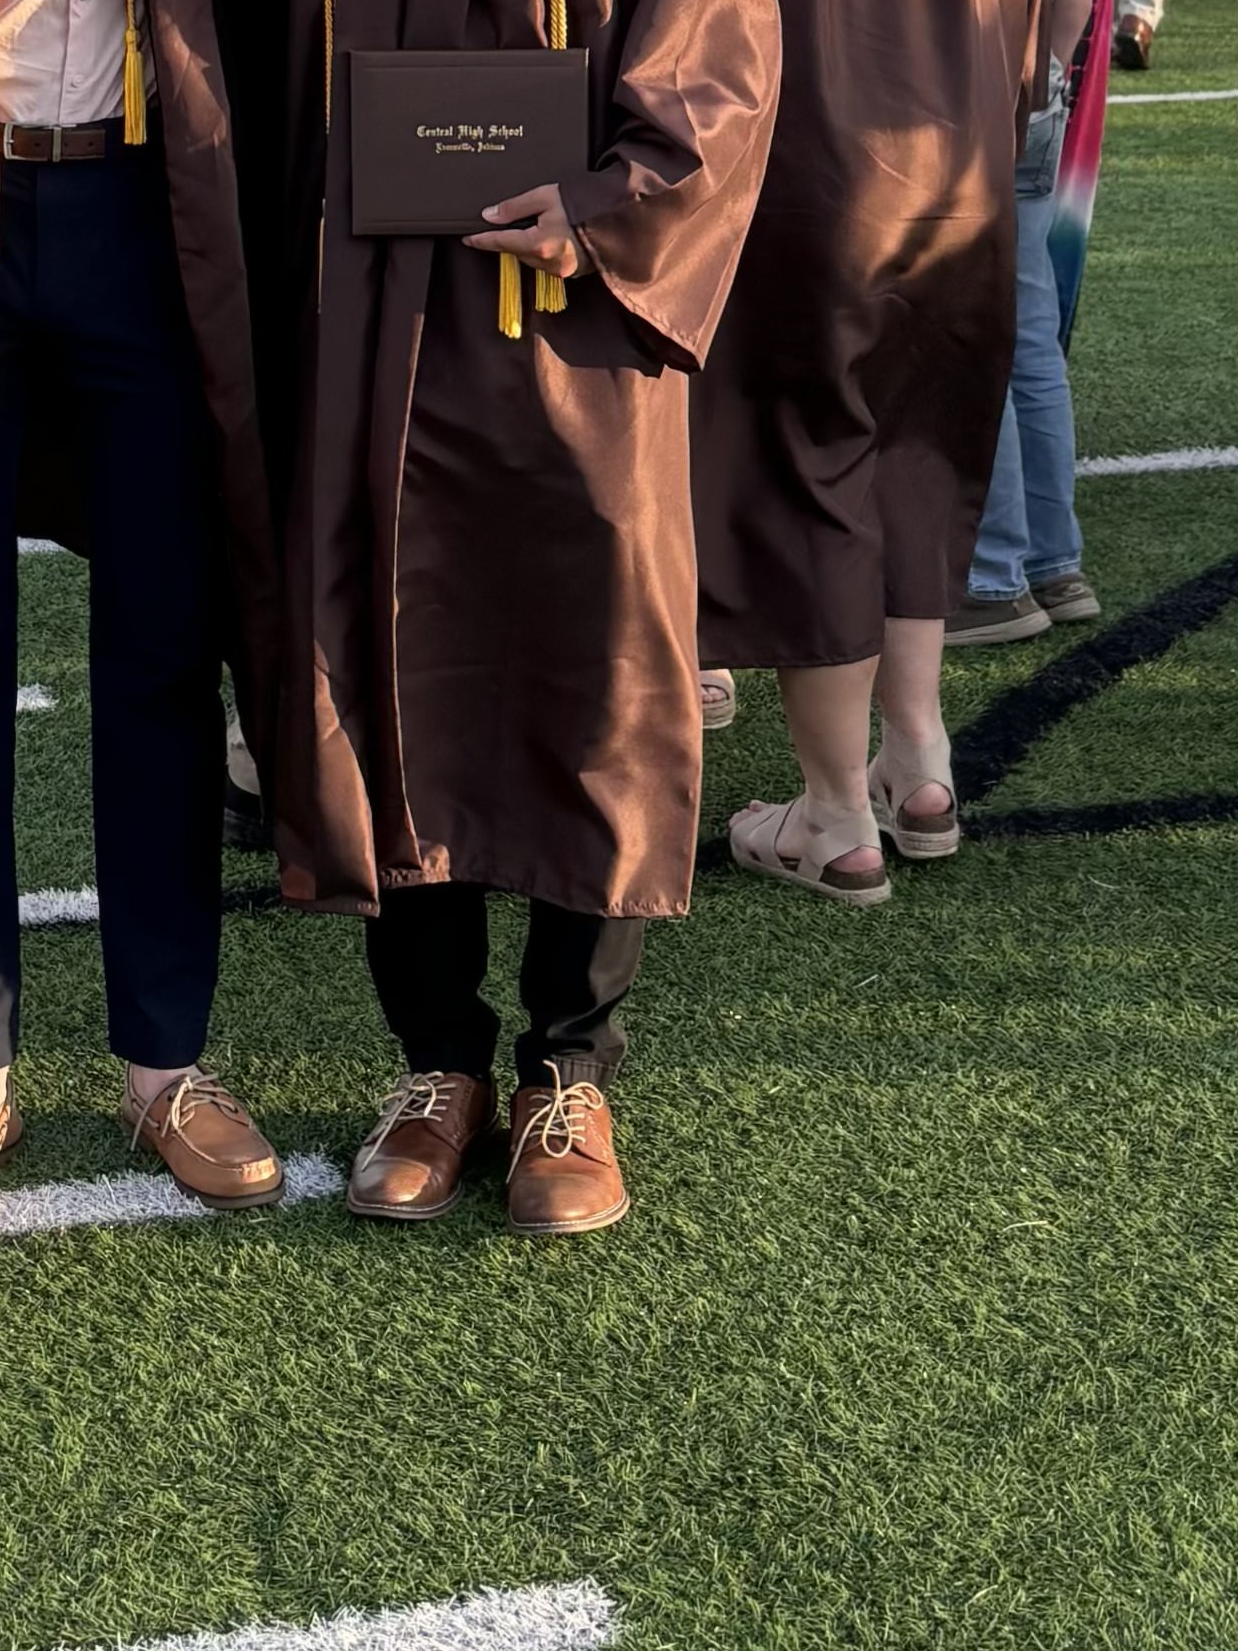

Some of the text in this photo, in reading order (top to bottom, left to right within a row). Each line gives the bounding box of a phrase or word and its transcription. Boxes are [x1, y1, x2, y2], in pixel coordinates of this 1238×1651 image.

[416, 125, 524, 140] Central High School
